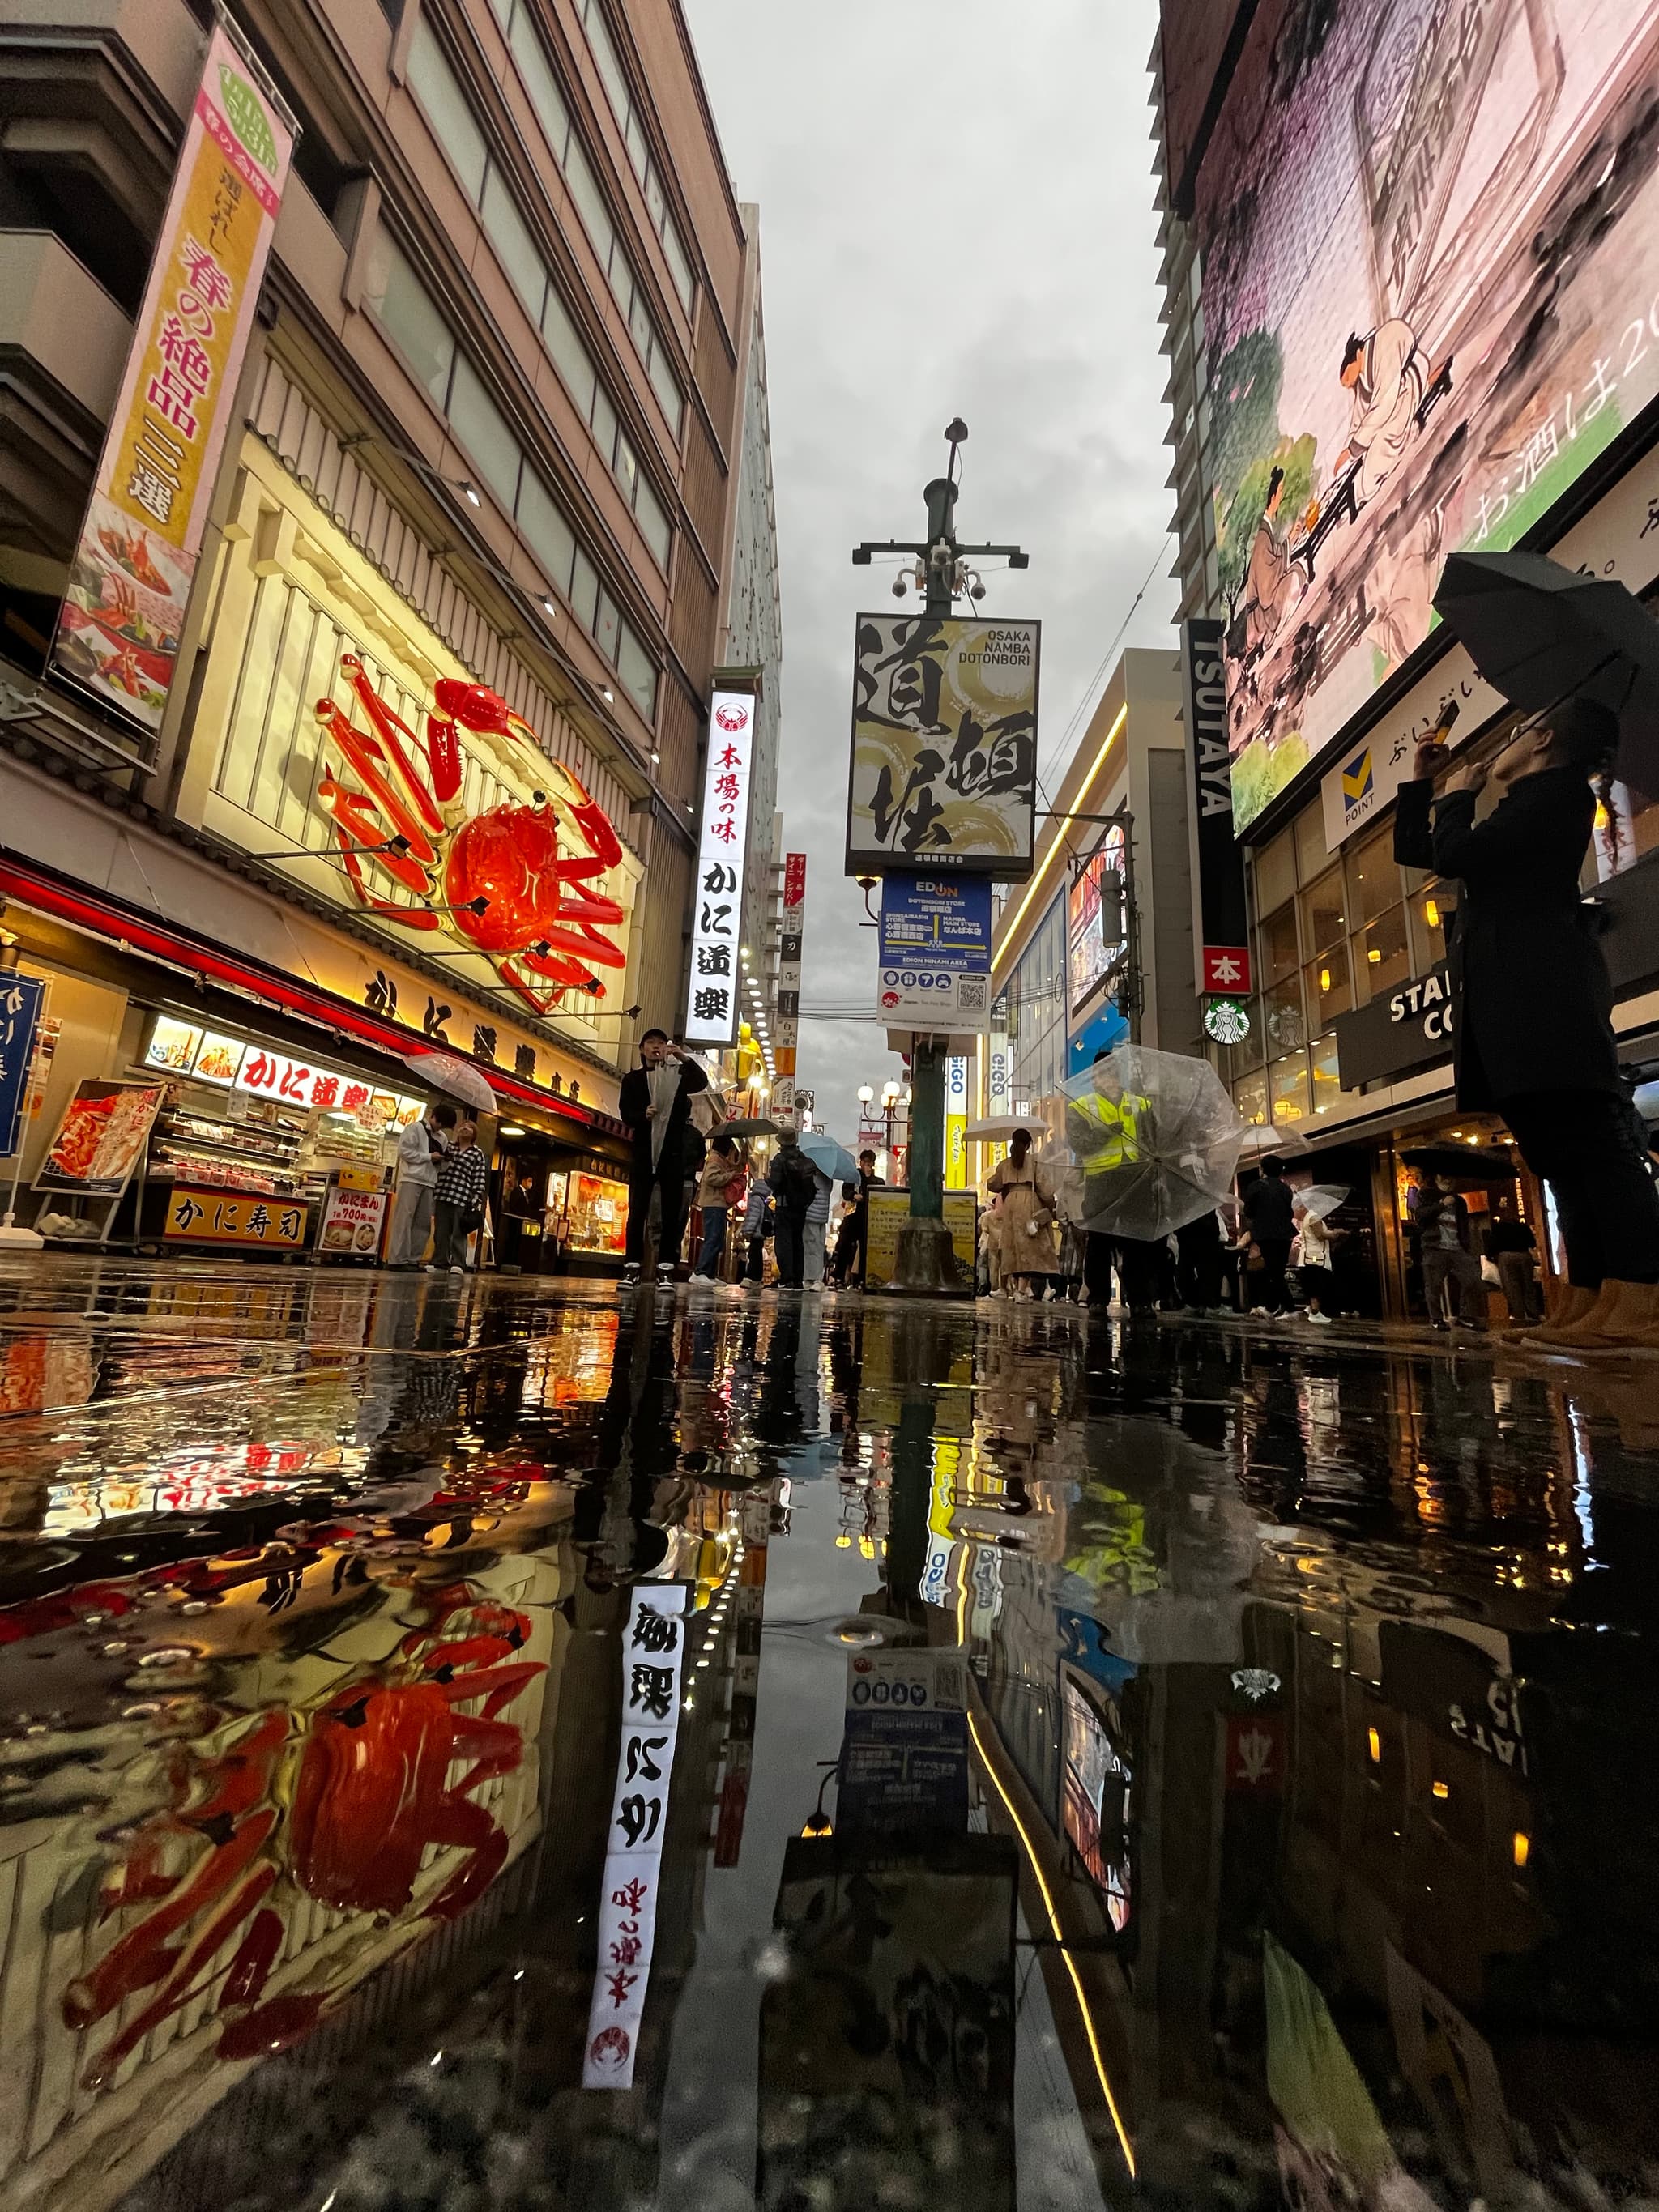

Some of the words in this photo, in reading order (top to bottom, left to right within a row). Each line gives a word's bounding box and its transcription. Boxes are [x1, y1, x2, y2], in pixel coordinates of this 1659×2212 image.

[984, 641, 1030, 654] NAMBA
[987, 629, 1031, 642] OSAKA
[958, 653, 1030, 667] DOTONBORI
[1194, 635, 1233, 817] TSUTAYA
[710, 742, 743, 846] 本場の味
[1345, 792, 1375, 827] POINT
[915, 881, 959, 897] EDION
[1211, 955, 1242, 985] 本
[1390, 970, 1451, 1022] STA
[174, 1198, 302, 1242] かに寿司
